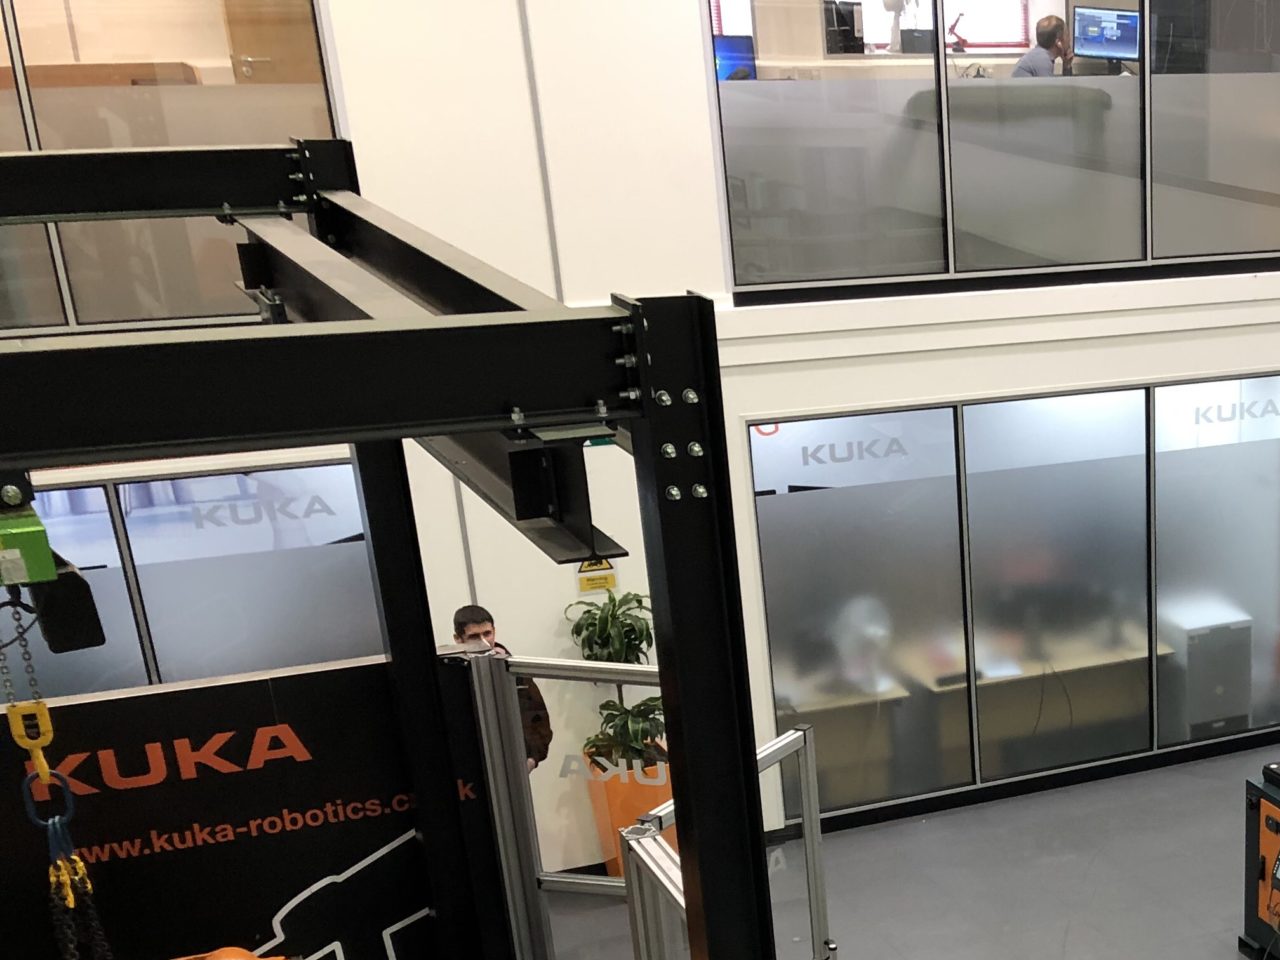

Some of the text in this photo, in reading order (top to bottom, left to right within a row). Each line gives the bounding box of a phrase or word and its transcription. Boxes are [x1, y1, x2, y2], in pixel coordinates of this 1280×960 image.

[1195, 399, 1280, 425] KUKA
[801, 437, 908, 466] KUKA
[194, 495, 336, 530] KUKA
[24, 723, 313, 801] KUKA
